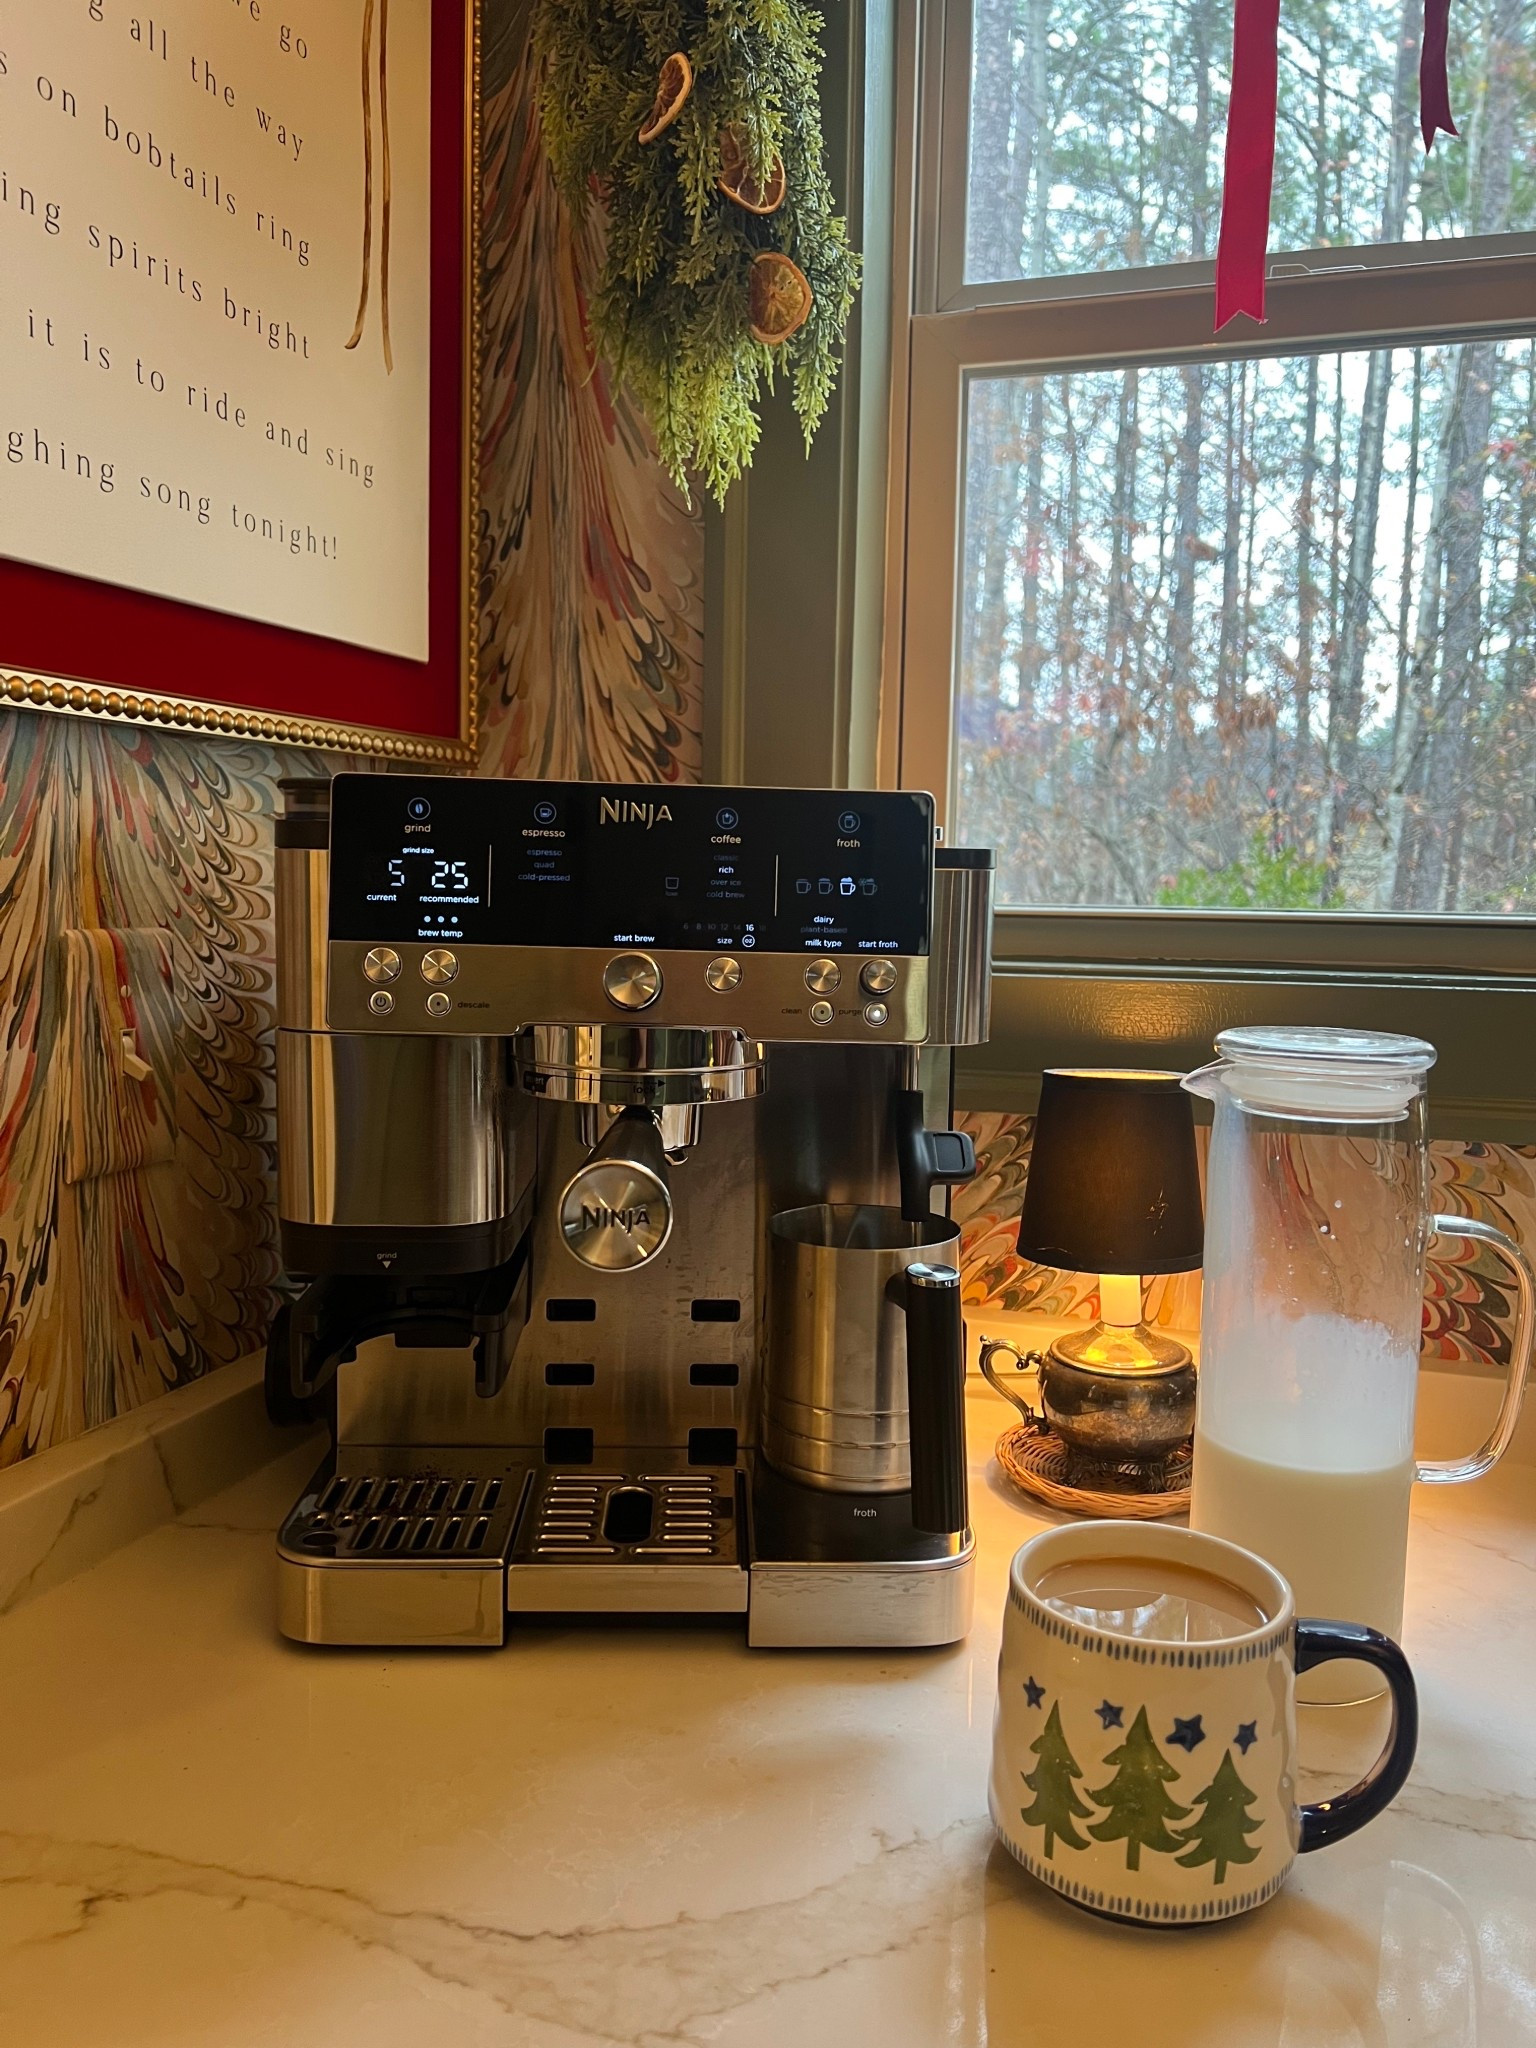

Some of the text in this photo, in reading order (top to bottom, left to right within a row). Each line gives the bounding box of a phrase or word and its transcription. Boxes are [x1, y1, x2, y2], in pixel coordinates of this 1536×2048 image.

[231, 0, 308, 59] e go
[130, 18, 167, 60] all
[191, 56, 235, 107] the
[256, 107, 303, 161] way
[37, 75, 77, 118] on
[105, 105, 236, 215] bobtails
[256, 211, 310, 267] ring
[1, 171, 310, 359] ing spirits bright
[28, 308, 374, 488] it is to ride and sing
[7, 428, 338, 561] ghing song tonight!
[600, 797, 673, 830] NINJA
[404, 823, 431, 833] grind
[522, 828, 566, 838] espresso
[710, 834, 742, 845] coffee
[836, 838, 861, 849] froth
[402, 846, 420, 855] grind
[526, 849, 563, 858] espresso
[533, 860, 555, 869] quad
[718, 865, 735, 874] rich
[431, 860, 469, 889] 25
[517, 872, 571, 882] cold-pressed
[366, 893, 397, 902] current
[419, 894, 480, 904] recommended
[706, 890, 723, 898] cold
[813, 915, 835, 925] dairy
[745, 923, 755, 932] 16
[418, 928, 464, 939] brew temp
[613, 934, 655, 943] start brew
[716, 937, 733, 945] size
[805, 938, 842, 949] milk type
[858, 940, 899, 949] start froth
[457, 1000, 491, 1009] descale
[781, 1007, 802, 1015] clean
[838, 1008, 862, 1016] purge
[581, 1203, 651, 1234] NINJA
[376, 1252, 398, 1260] grind
[853, 1507, 878, 1518] froth
